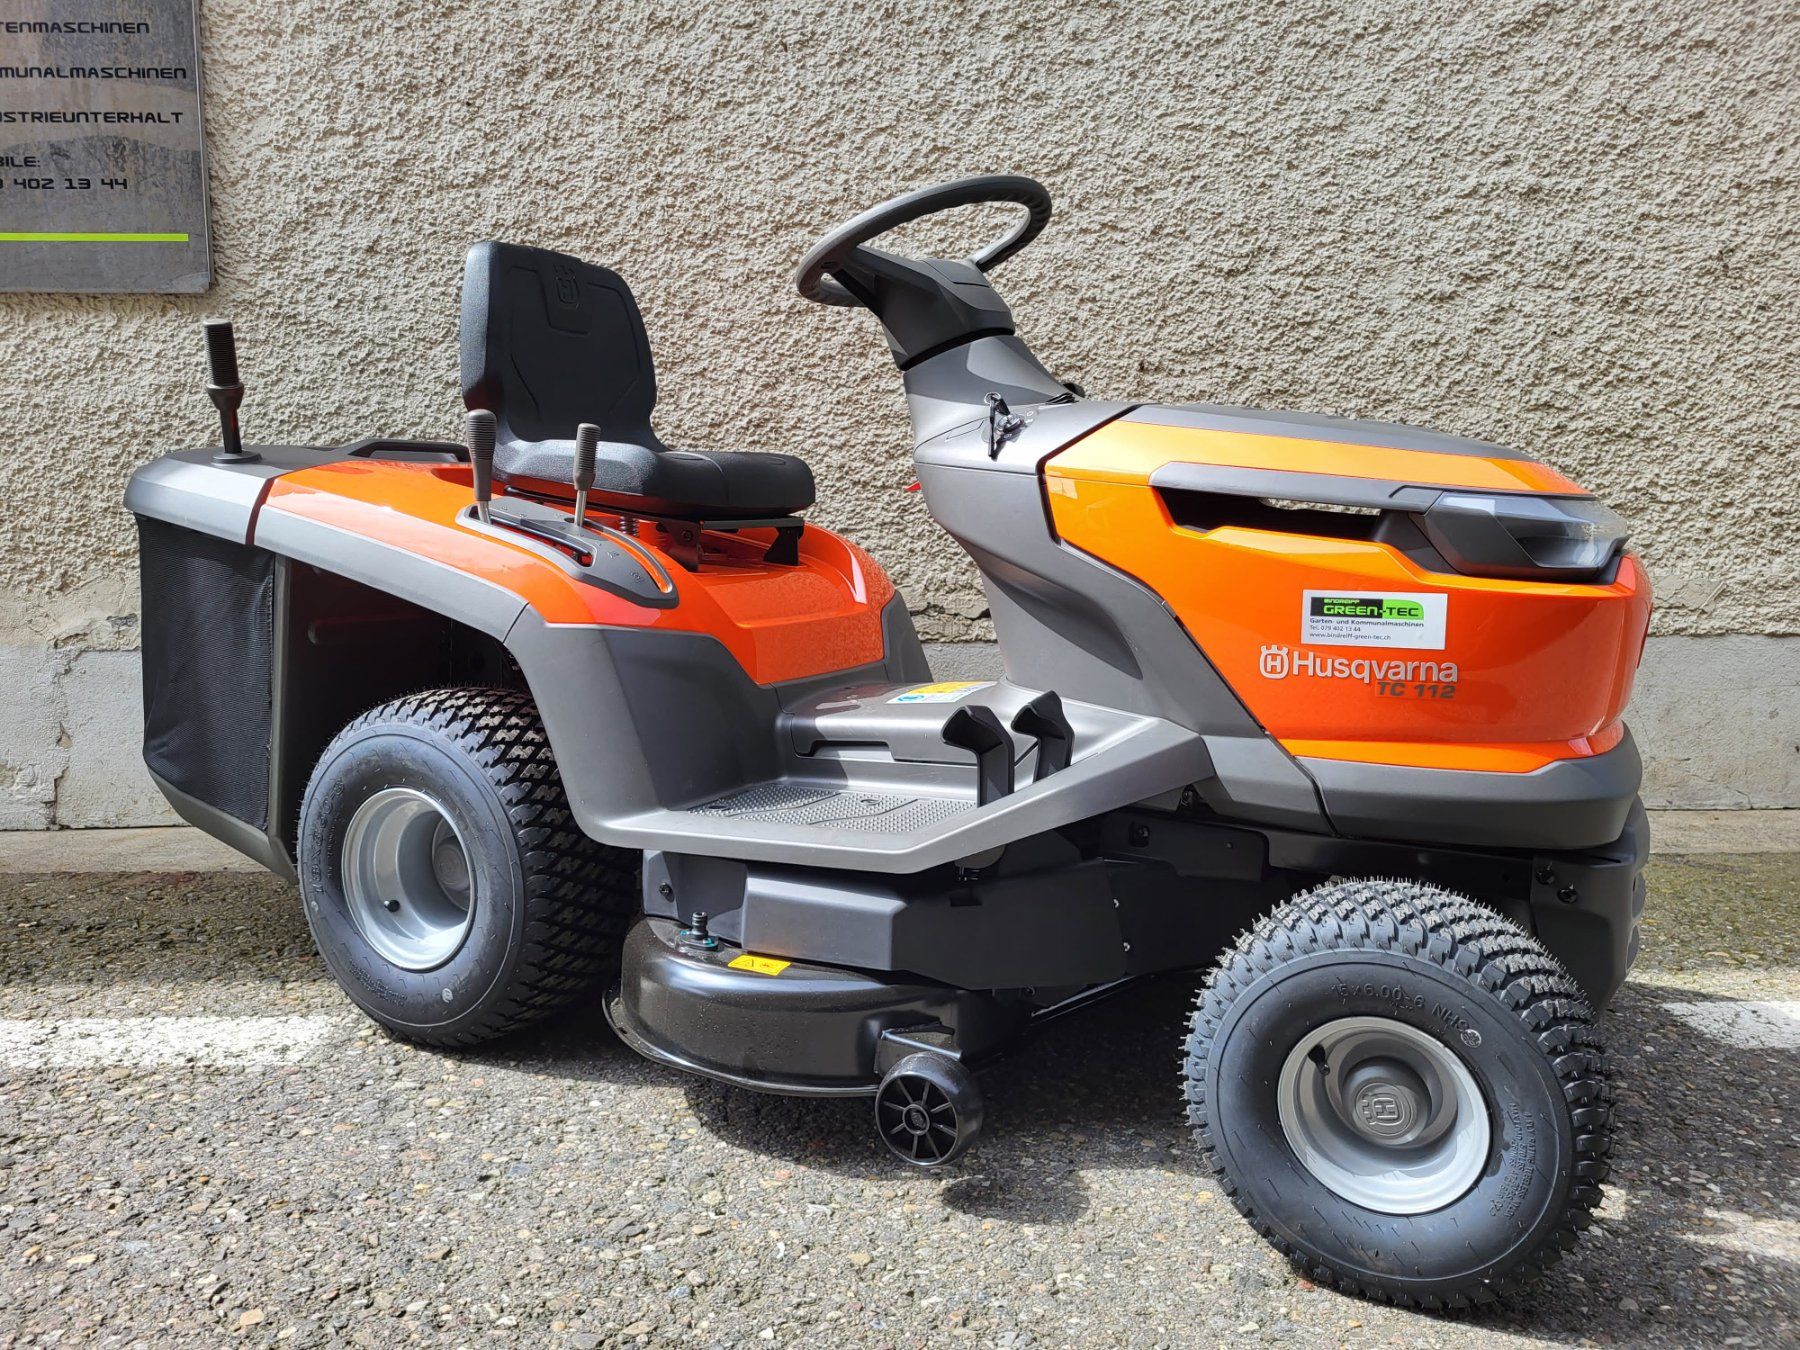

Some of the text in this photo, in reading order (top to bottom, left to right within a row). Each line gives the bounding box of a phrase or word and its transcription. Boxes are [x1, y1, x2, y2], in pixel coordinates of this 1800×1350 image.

[0, 112, 183, 124] STRIEUNTERHALT
[14, 178, 54, 190] 402
[65, 178, 91, 190] 13
[101, 178, 127, 190] 44
[1323, 605, 1419, 617] GREEN-TEC
[1351, 619, 1425, 627] Kommunalmaschinen
[1292, 651, 1458, 683] Husqvarna
[1377, 682, 1456, 699] TC 112
